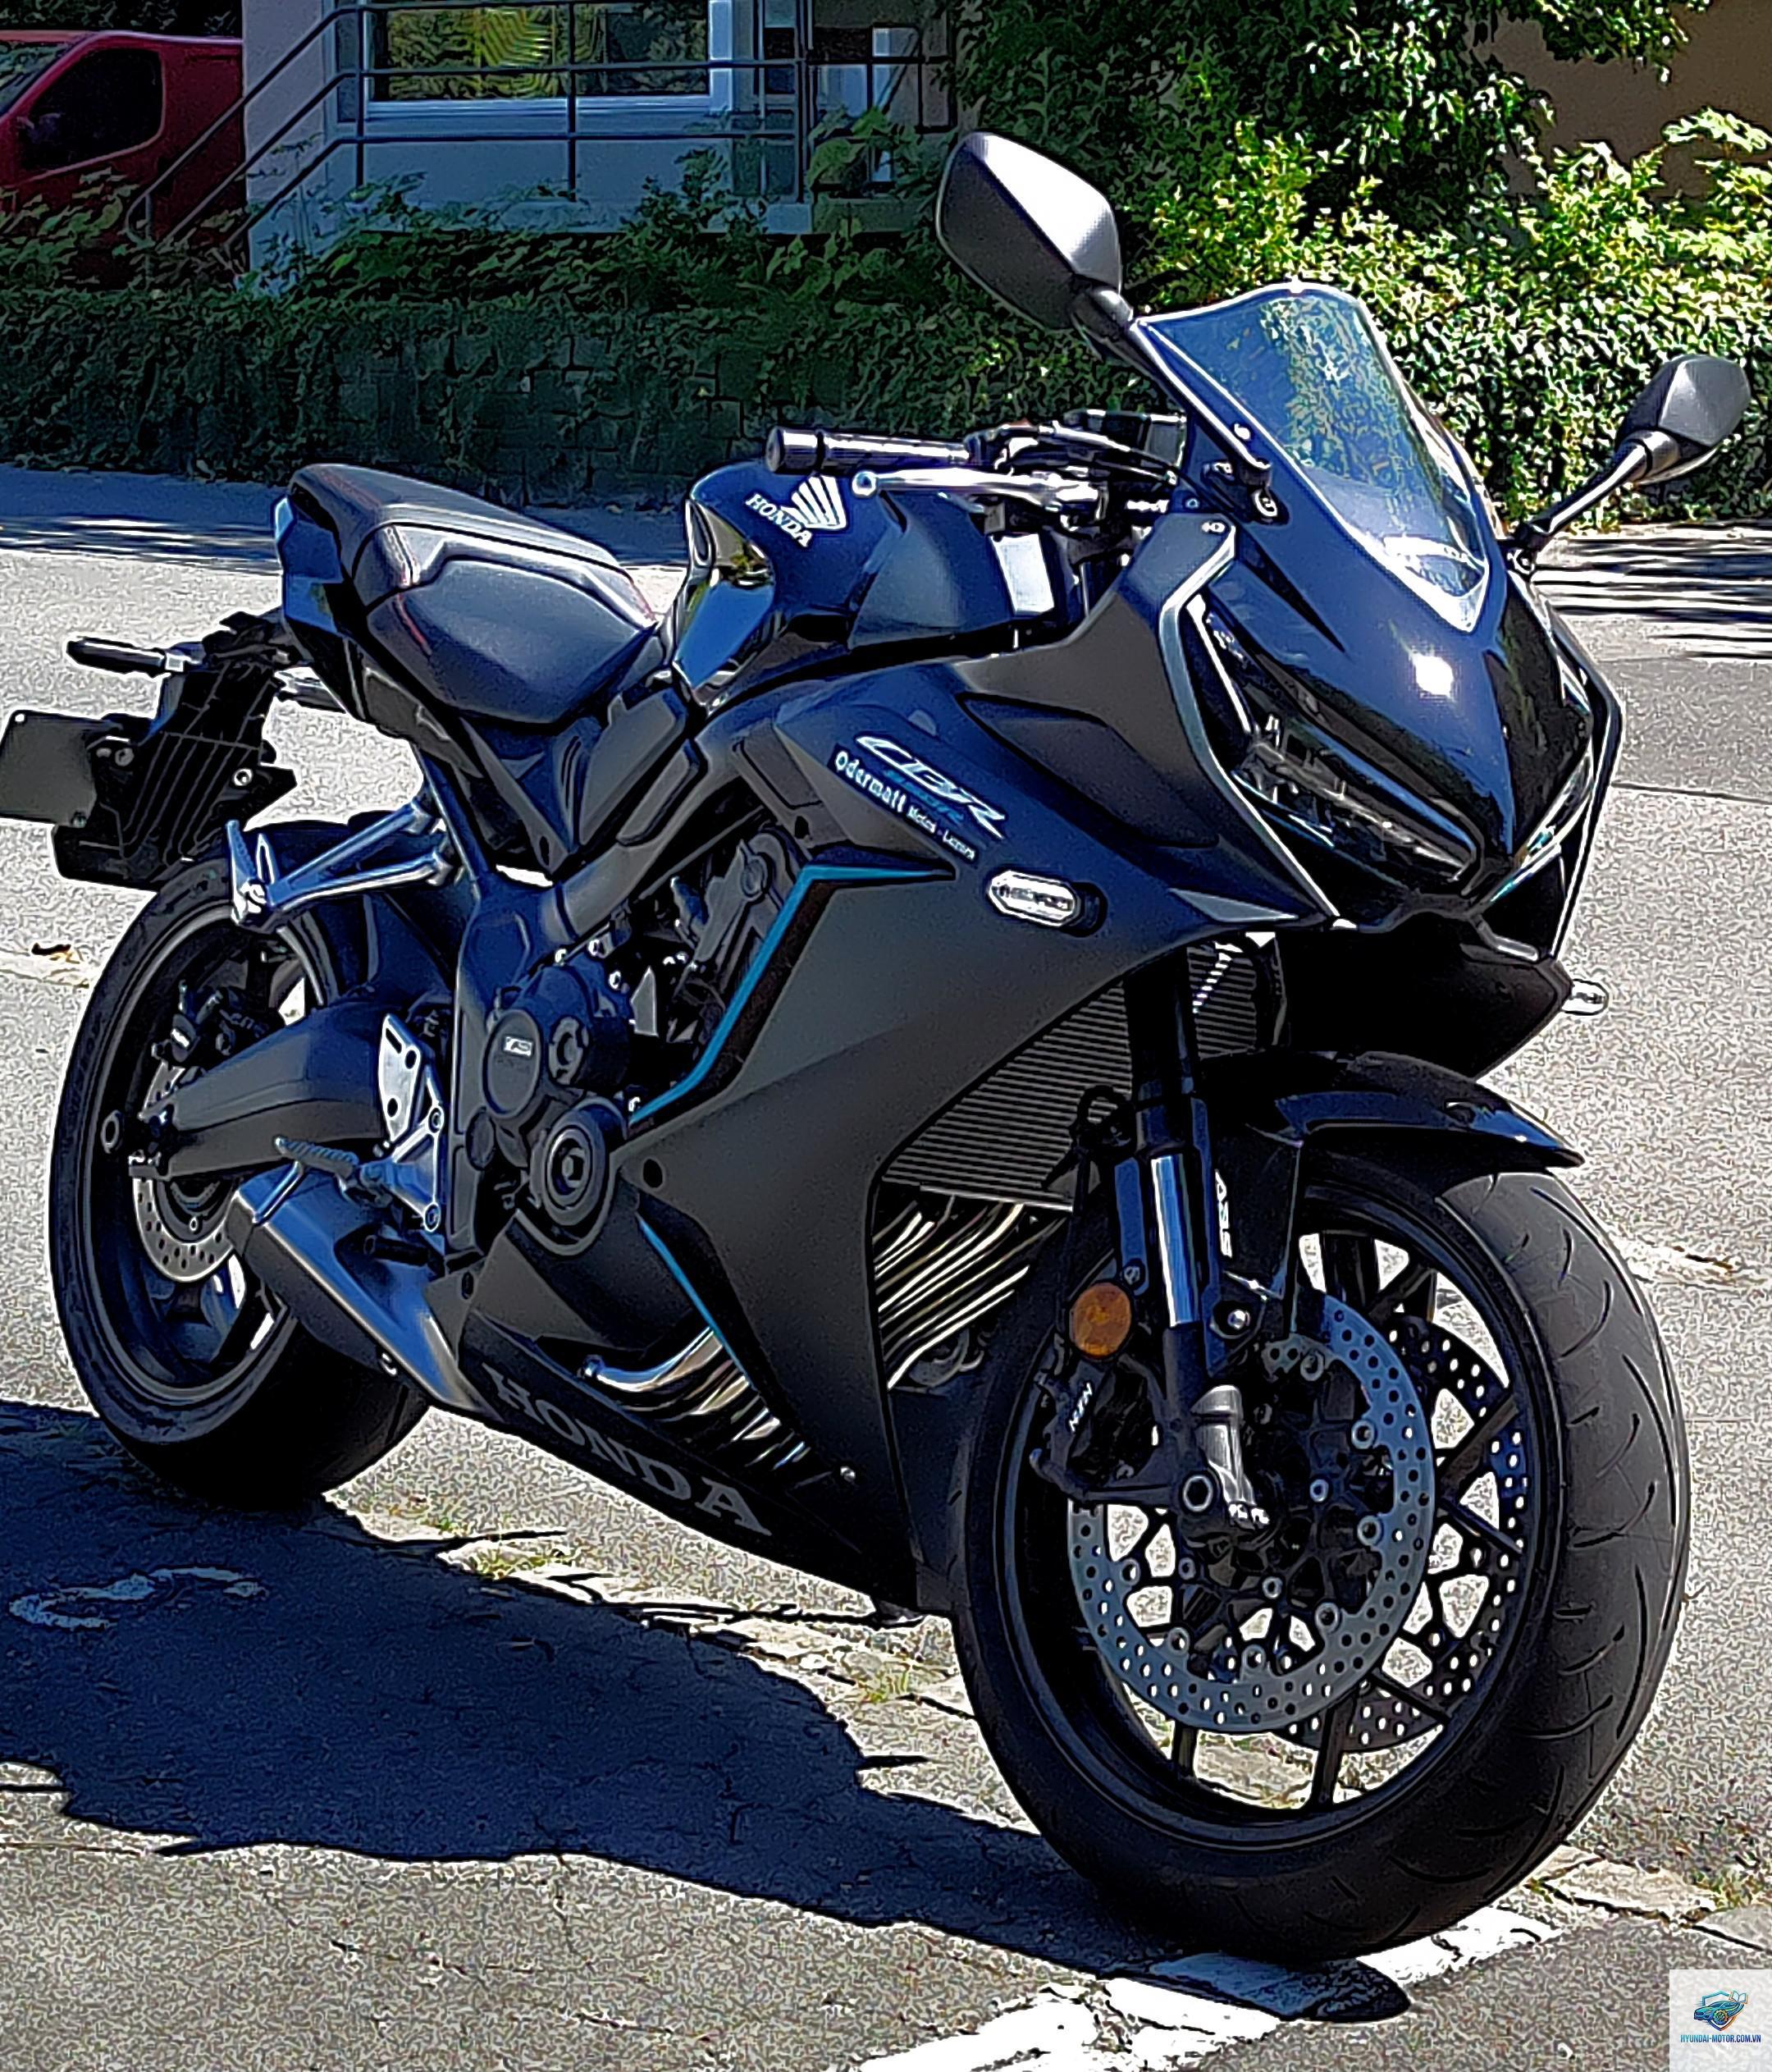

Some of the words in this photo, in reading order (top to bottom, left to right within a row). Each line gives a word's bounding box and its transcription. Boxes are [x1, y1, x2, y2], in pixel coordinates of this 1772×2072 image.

[745, 493, 812, 547] HONDA
[835, 751, 907, 812] Odermatt
[856, 736, 1006, 839] CBR
[1215, 1169, 1232, 1258] ABS
[482, 1362, 772, 1536] HONDA
